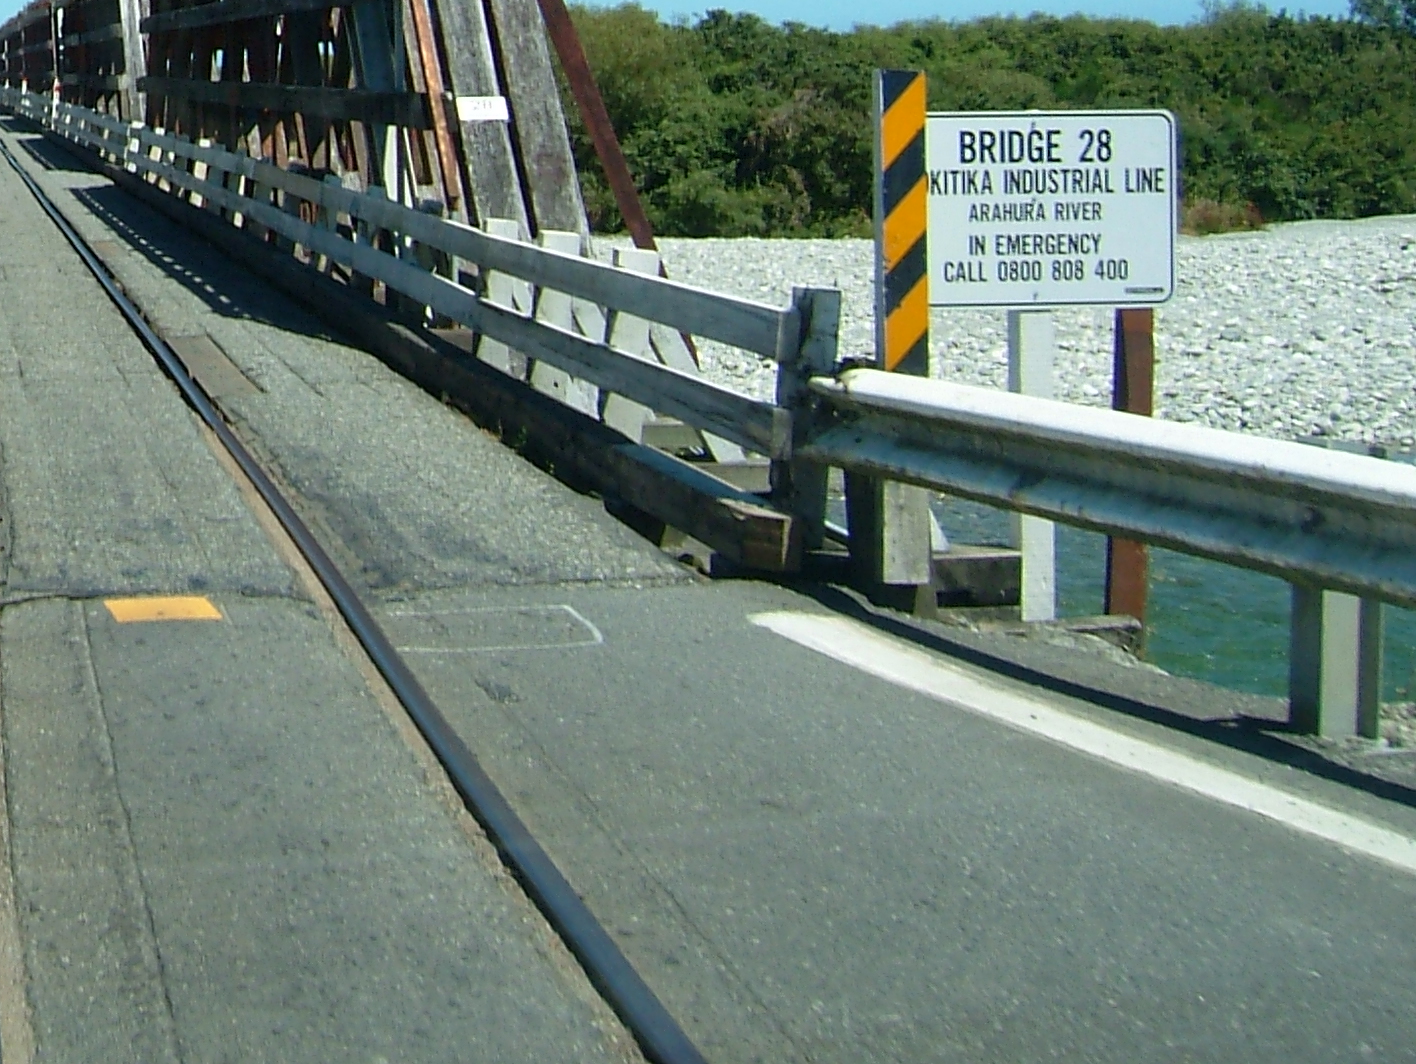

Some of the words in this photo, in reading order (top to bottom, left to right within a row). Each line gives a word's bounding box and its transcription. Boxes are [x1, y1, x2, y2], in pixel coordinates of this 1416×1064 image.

[959, 130, 1062, 164] BRIDGE
[1078, 129, 1112, 163] 28
[929, 169, 993, 195] KITIKA
[1004, 168, 1115, 195] INDUSTRIAL
[1124, 167, 1165, 194] LINE
[968, 203, 1046, 222] ARAHURA
[1054, 201, 1102, 221] RIVER
[969, 235, 986, 256] IN
[995, 233, 1102, 256] EMERGENCY
[944, 261, 988, 283] CALL
[997, 260, 1042, 282] 0800
[1051, 259, 1085, 281] 808
[1094, 259, 1129, 280] 400
